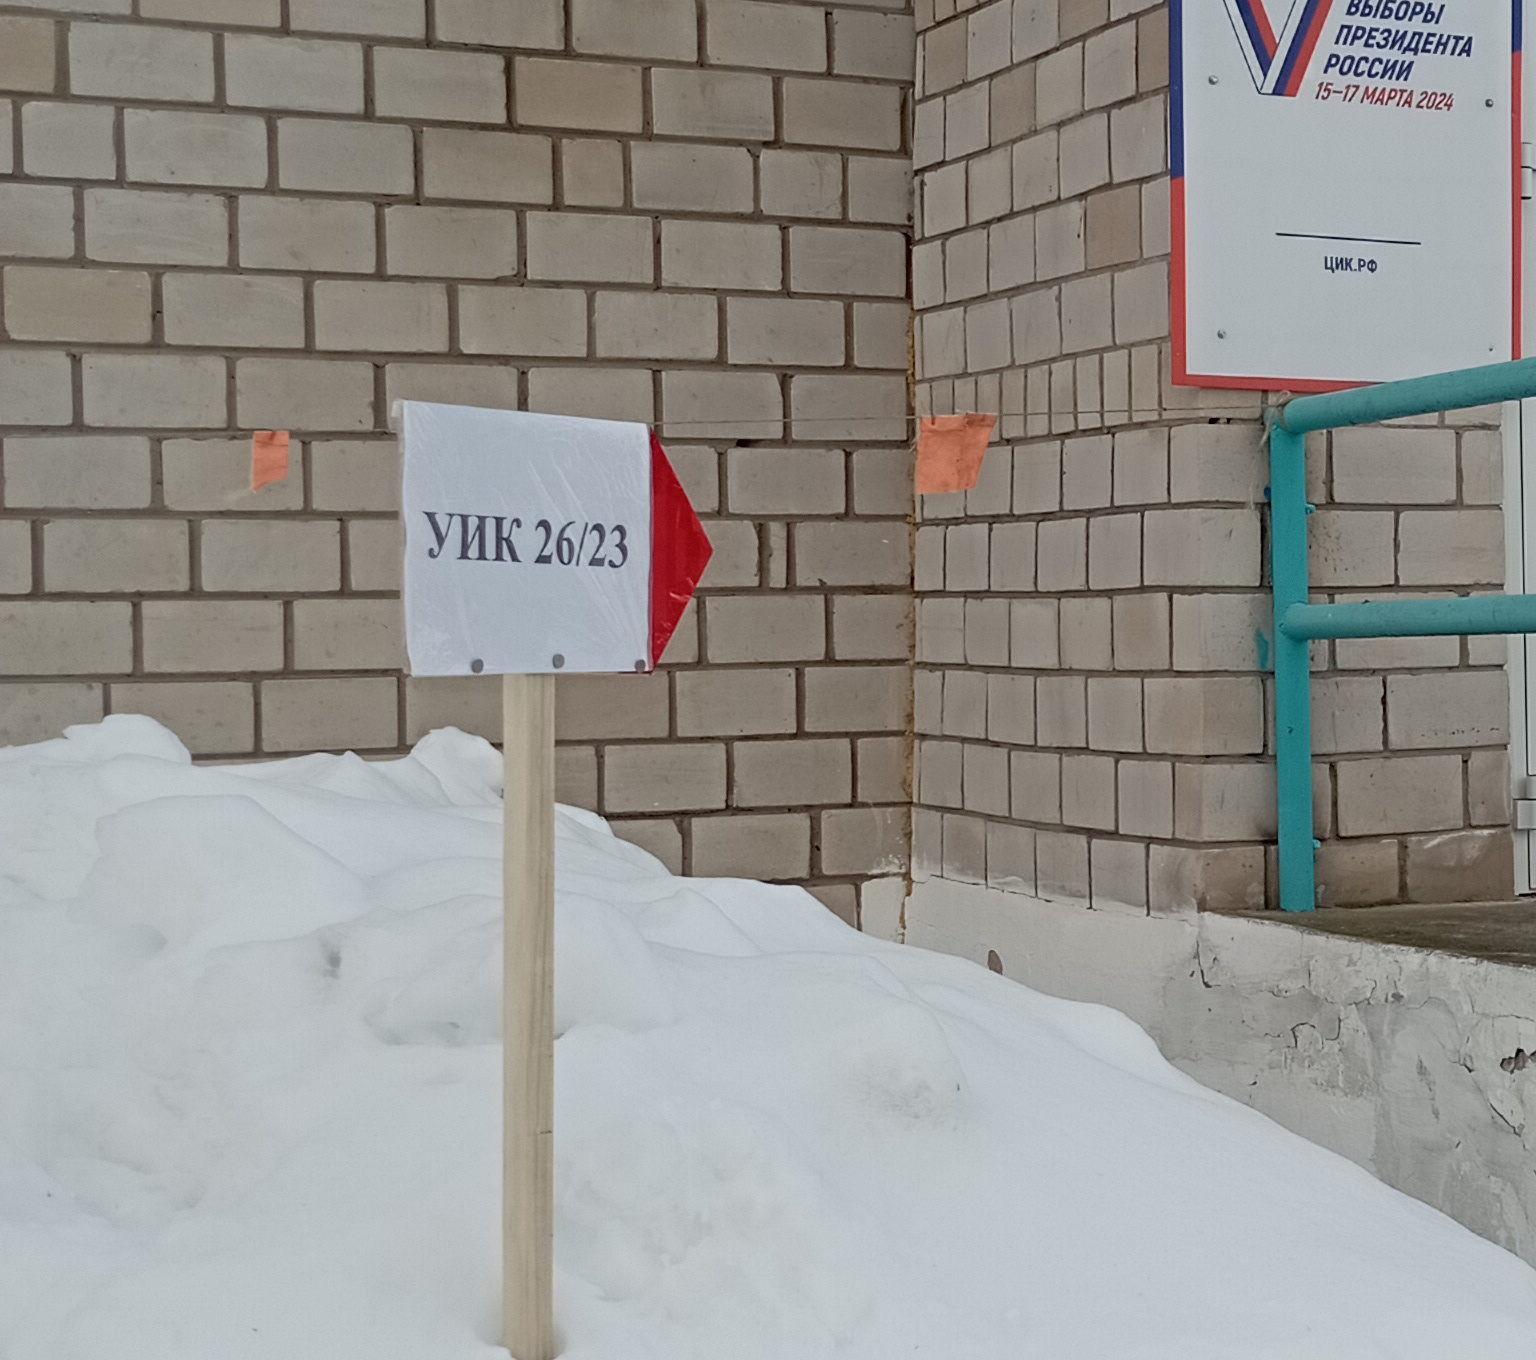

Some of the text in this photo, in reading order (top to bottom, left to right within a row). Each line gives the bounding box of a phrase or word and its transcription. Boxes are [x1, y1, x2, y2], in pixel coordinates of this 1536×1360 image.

[1334, 24, 1474, 57] ПРЕЗИДЕНТА
[1323, 53, 1414, 81] РОССИИ
[1360, 87, 1412, 108] МАРТА
[1416, 91, 1454, 111] 2024
[1324, 255, 1378, 273] ЦИК.РФ
[422, 510, 629, 568] УИК 26/23
